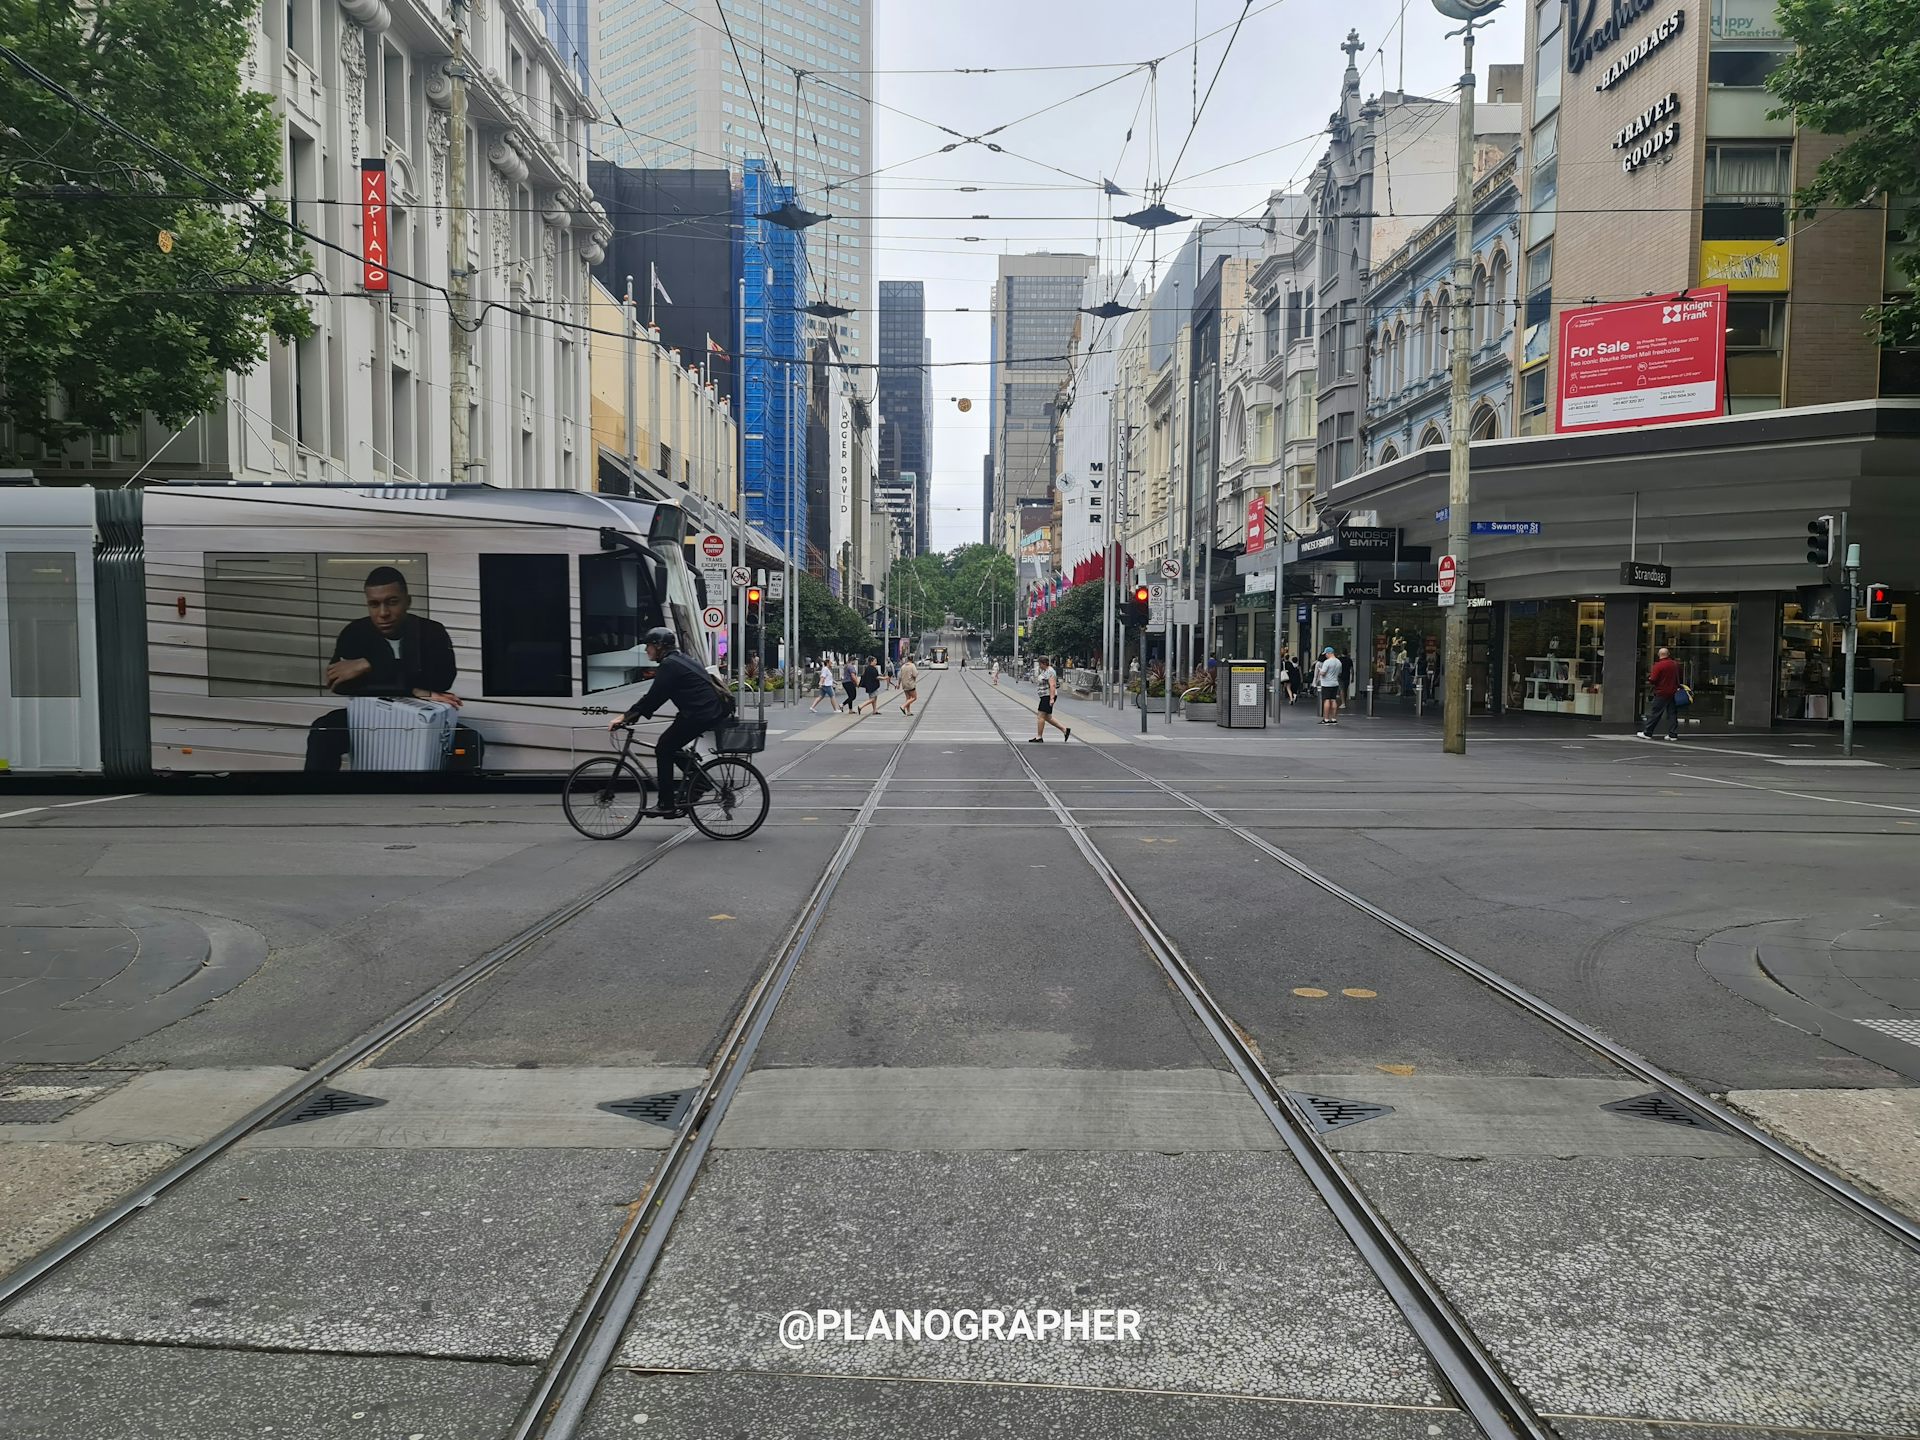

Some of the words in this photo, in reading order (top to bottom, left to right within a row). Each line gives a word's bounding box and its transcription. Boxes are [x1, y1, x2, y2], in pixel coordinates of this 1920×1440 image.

[1622, 122, 1677, 172] GOODS
[1682, 300, 1712, 312] Knight
[1682, 310, 1708, 321] Frank
[1570, 346, 1595, 358] For
[1597, 341, 1630, 354] Sale
[1652, 347, 1681, 355] freeholds
[840, 410, 849, 459] ROGER
[840, 466, 848, 514] DAVID
[1089, 462, 1103, 523] MYER
[1491, 521, 1529, 531] Swanston
[1530, 521, 1539, 530] St
[1350, 539, 1389, 547] SMITH
[1443, 561, 1451, 569] NO
[1634, 566, 1667, 586] Strandbags
[1440, 579, 1453, 587] ENTRY
[708, 613, 719, 622] 10
[581, 706, 609, 716] 3526
